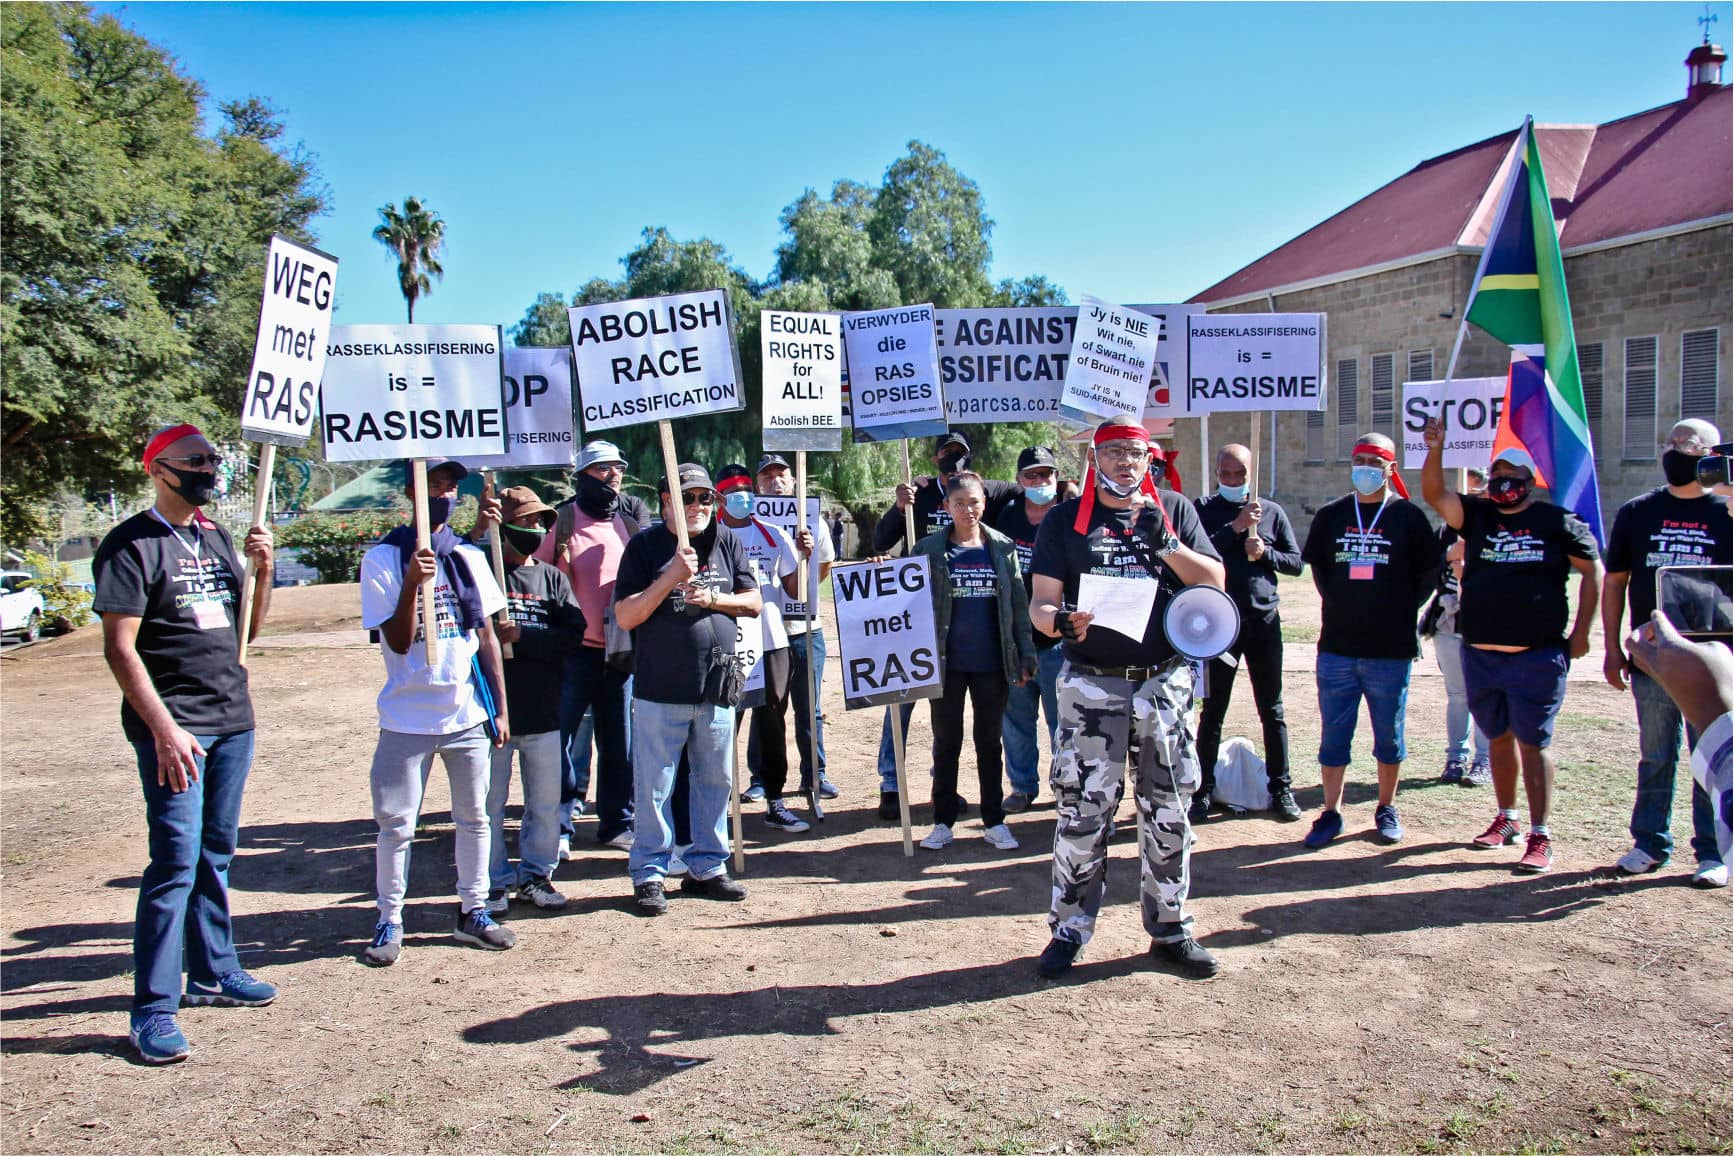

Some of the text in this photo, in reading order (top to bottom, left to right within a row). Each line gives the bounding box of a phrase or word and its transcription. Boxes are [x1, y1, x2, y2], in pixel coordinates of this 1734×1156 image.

[274, 252, 331, 311] WEG
[577, 300, 722, 346] ABOLISH
[770, 314, 832, 336] EQUAL
[847, 309, 931, 331] VERWYDER
[1090, 306, 1107, 322] Jy
[1110, 312, 1121, 326] is
[1125, 318, 1149, 336] NIE
[954, 316, 1078, 347] AGAINST
[1097, 327, 1114, 342] Wit
[1191, 327, 1317, 338] RASSEKLASSIFISERING
[272, 324, 316, 362] met
[326, 343, 495, 357] RASSEKLASSIFISERING
[769, 341, 835, 361] RIGHTS
[878, 335, 906, 353] die
[611, 346, 702, 385] RACE
[1082, 341, 1145, 369] of Swart nie
[1237, 349, 1252, 363] is
[792, 362, 813, 376] for
[875, 362, 916, 382] RAS
[1076, 355, 1143, 384] of Bruin nie!
[388, 373, 408, 392] is
[782, 381, 824, 400] ALL!
[1091, 383, 1102, 392] JY
[1102, 386, 1110, 395] IS
[1191, 376, 1317, 399] RASISME
[250, 370, 314, 426] RAS
[585, 383, 735, 422] CLASSIFICATION
[862, 383, 932, 406] OPSIES
[1070, 386, 1138, 414] SUID-AFRIKANER
[326, 408, 500, 444] RASISME
[770, 415, 809, 426] Abolish
[752, 501, 811, 518] QUA
[1343, 542, 1349, 552] I
[1658, 541, 1703, 554] I am a
[1102, 552, 1137, 566] I am
[837, 562, 925, 602] WEG
[956, 578, 962, 587] I
[436, 612, 449, 621] m
[864, 609, 912, 637] met
[850, 648, 934, 693] RAS
